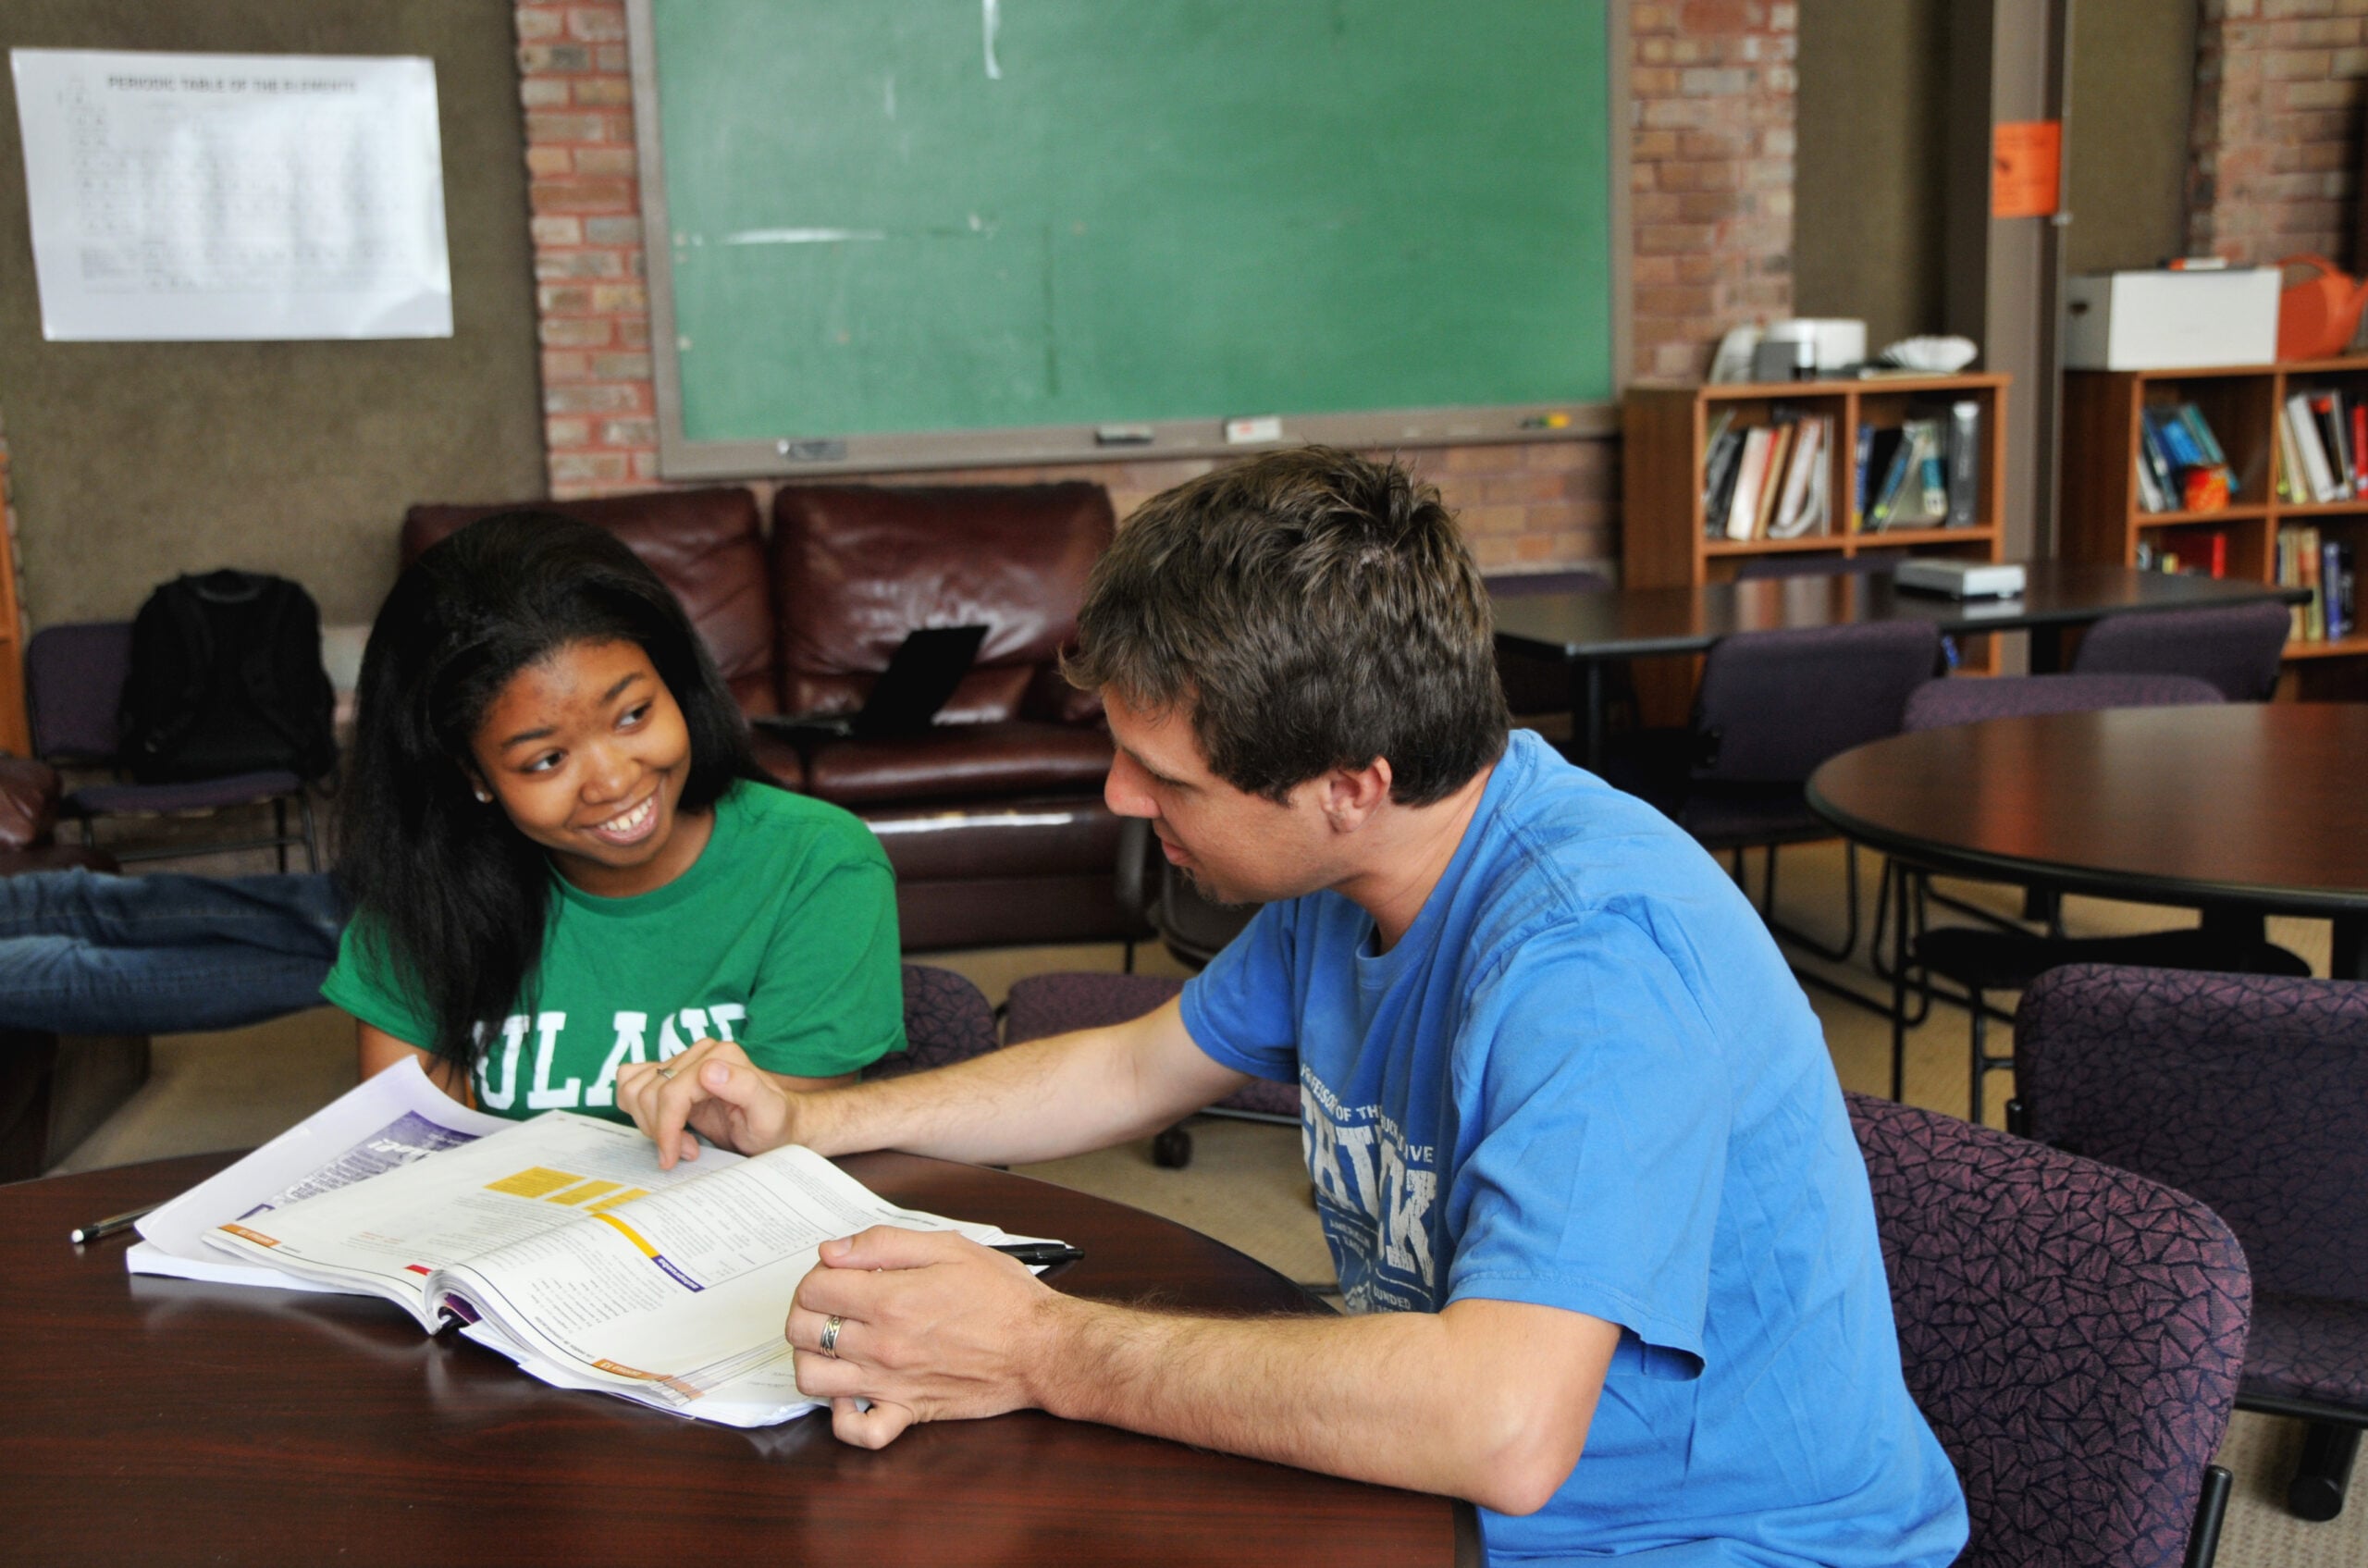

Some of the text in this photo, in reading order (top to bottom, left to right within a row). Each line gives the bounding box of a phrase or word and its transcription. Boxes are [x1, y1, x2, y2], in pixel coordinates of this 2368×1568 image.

[181, 77, 224, 93] TABLE
[230, 78, 247, 92] OF
[253, 78, 278, 92] THE
[1336, 1105, 1352, 1122] OF
[1355, 1104, 1382, 1121] TH
